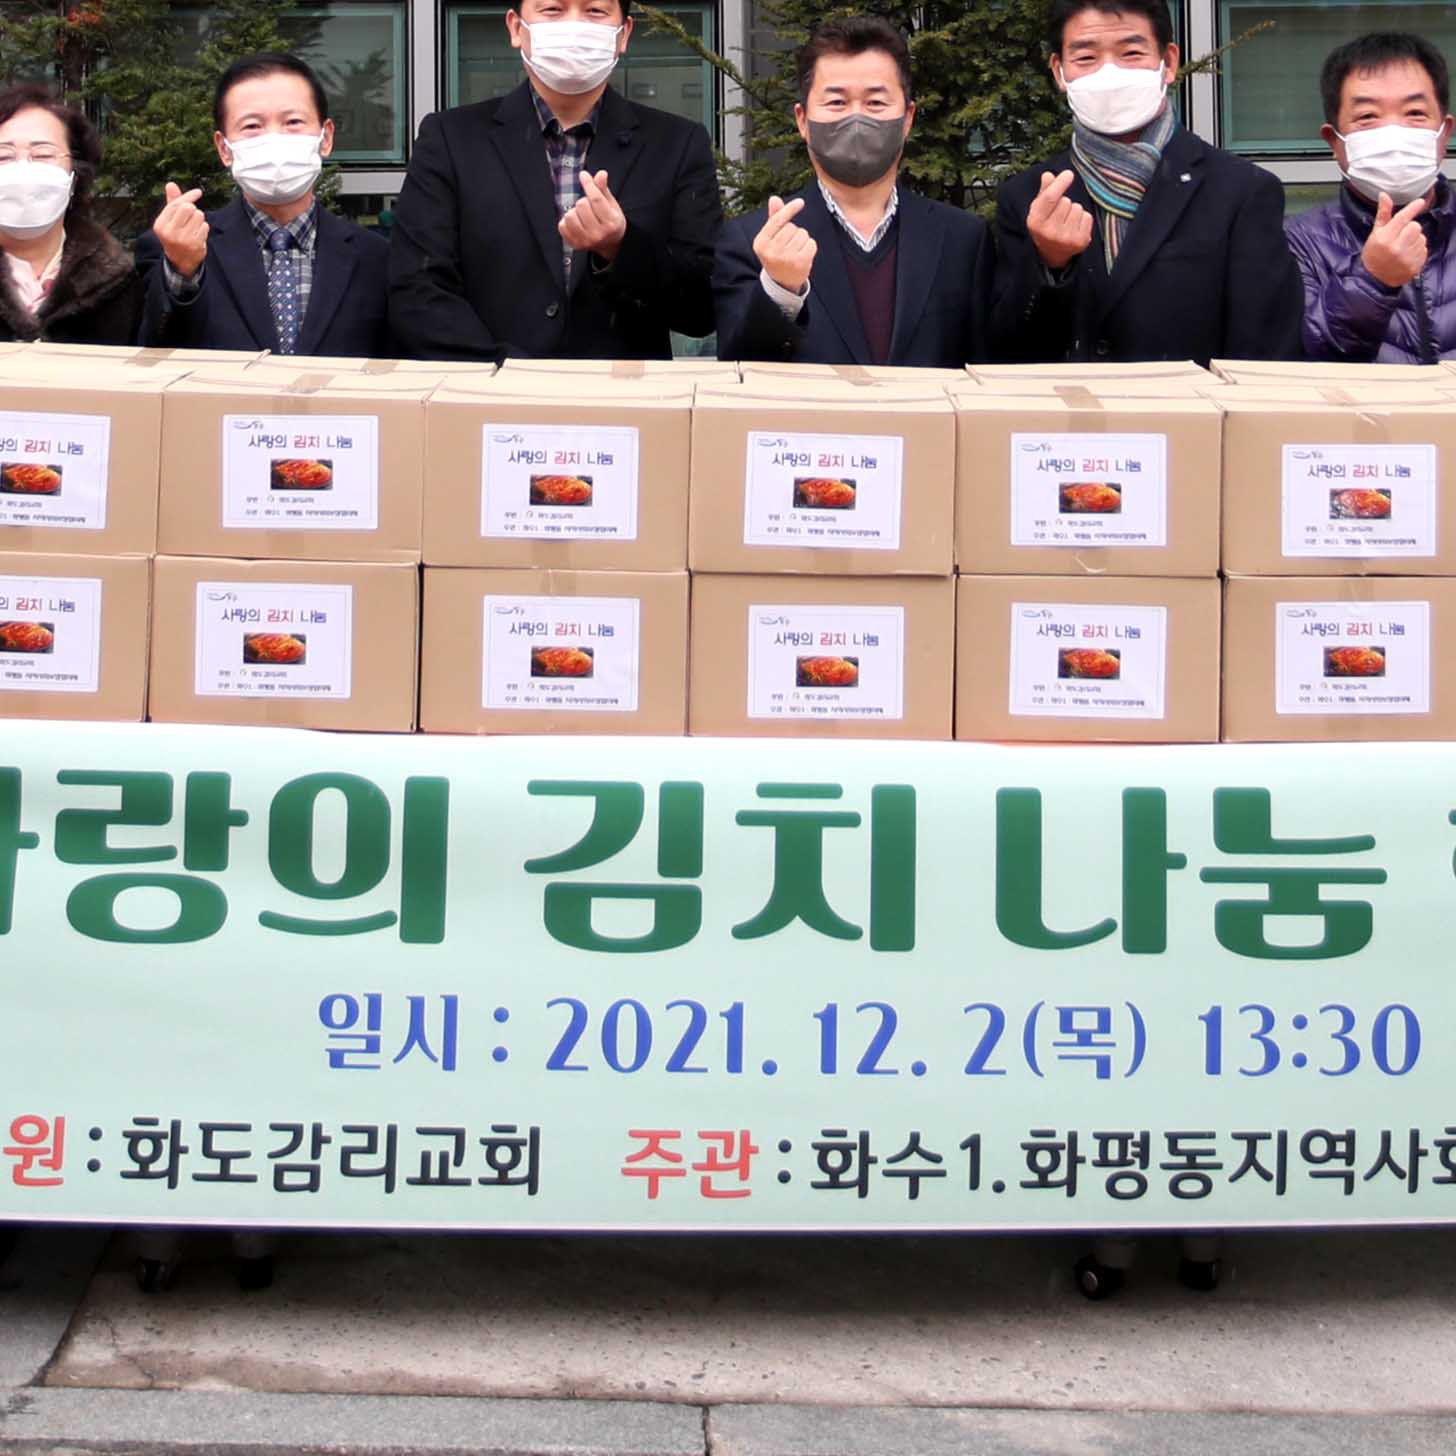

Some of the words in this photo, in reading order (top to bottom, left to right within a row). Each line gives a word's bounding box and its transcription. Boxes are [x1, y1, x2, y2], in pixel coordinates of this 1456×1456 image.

[23, 438, 51, 453] 김치
[247, 433, 287, 449] 사랑의
[292, 434, 320, 449] 김치
[507, 449, 547, 465] 사랑의
[553, 450, 580, 465] 김치
[771, 452, 811, 467] 사랑의
[817, 453, 844, 467] 김치
[1036, 457, 1076, 473] 사랑의
[1081, 458, 1109, 472] 김치
[1307, 463, 1346, 479] 사랑의
[1352, 463, 1378, 478] 김치
[14, 596, 42, 611] 김치
[220, 607, 261, 623] 사랑의
[266, 608, 294, 623] 김치
[509, 621, 548, 637] 사랑의
[554, 622, 581, 636] 김치
[1035, 622, 1076, 638] 사랑의
[1081, 624, 1108, 638] 김치
[1300, 622, 1340, 637] 사랑의
[1346, 622, 1372, 636] 김치
[773, 631, 813, 647] 사랑의
[819, 631, 846, 646] 김치
[523, 777, 918, 955] 김치
[997, 784, 1389, 962] 나눔
[1199, 1004, 1423, 1078] 13:30
